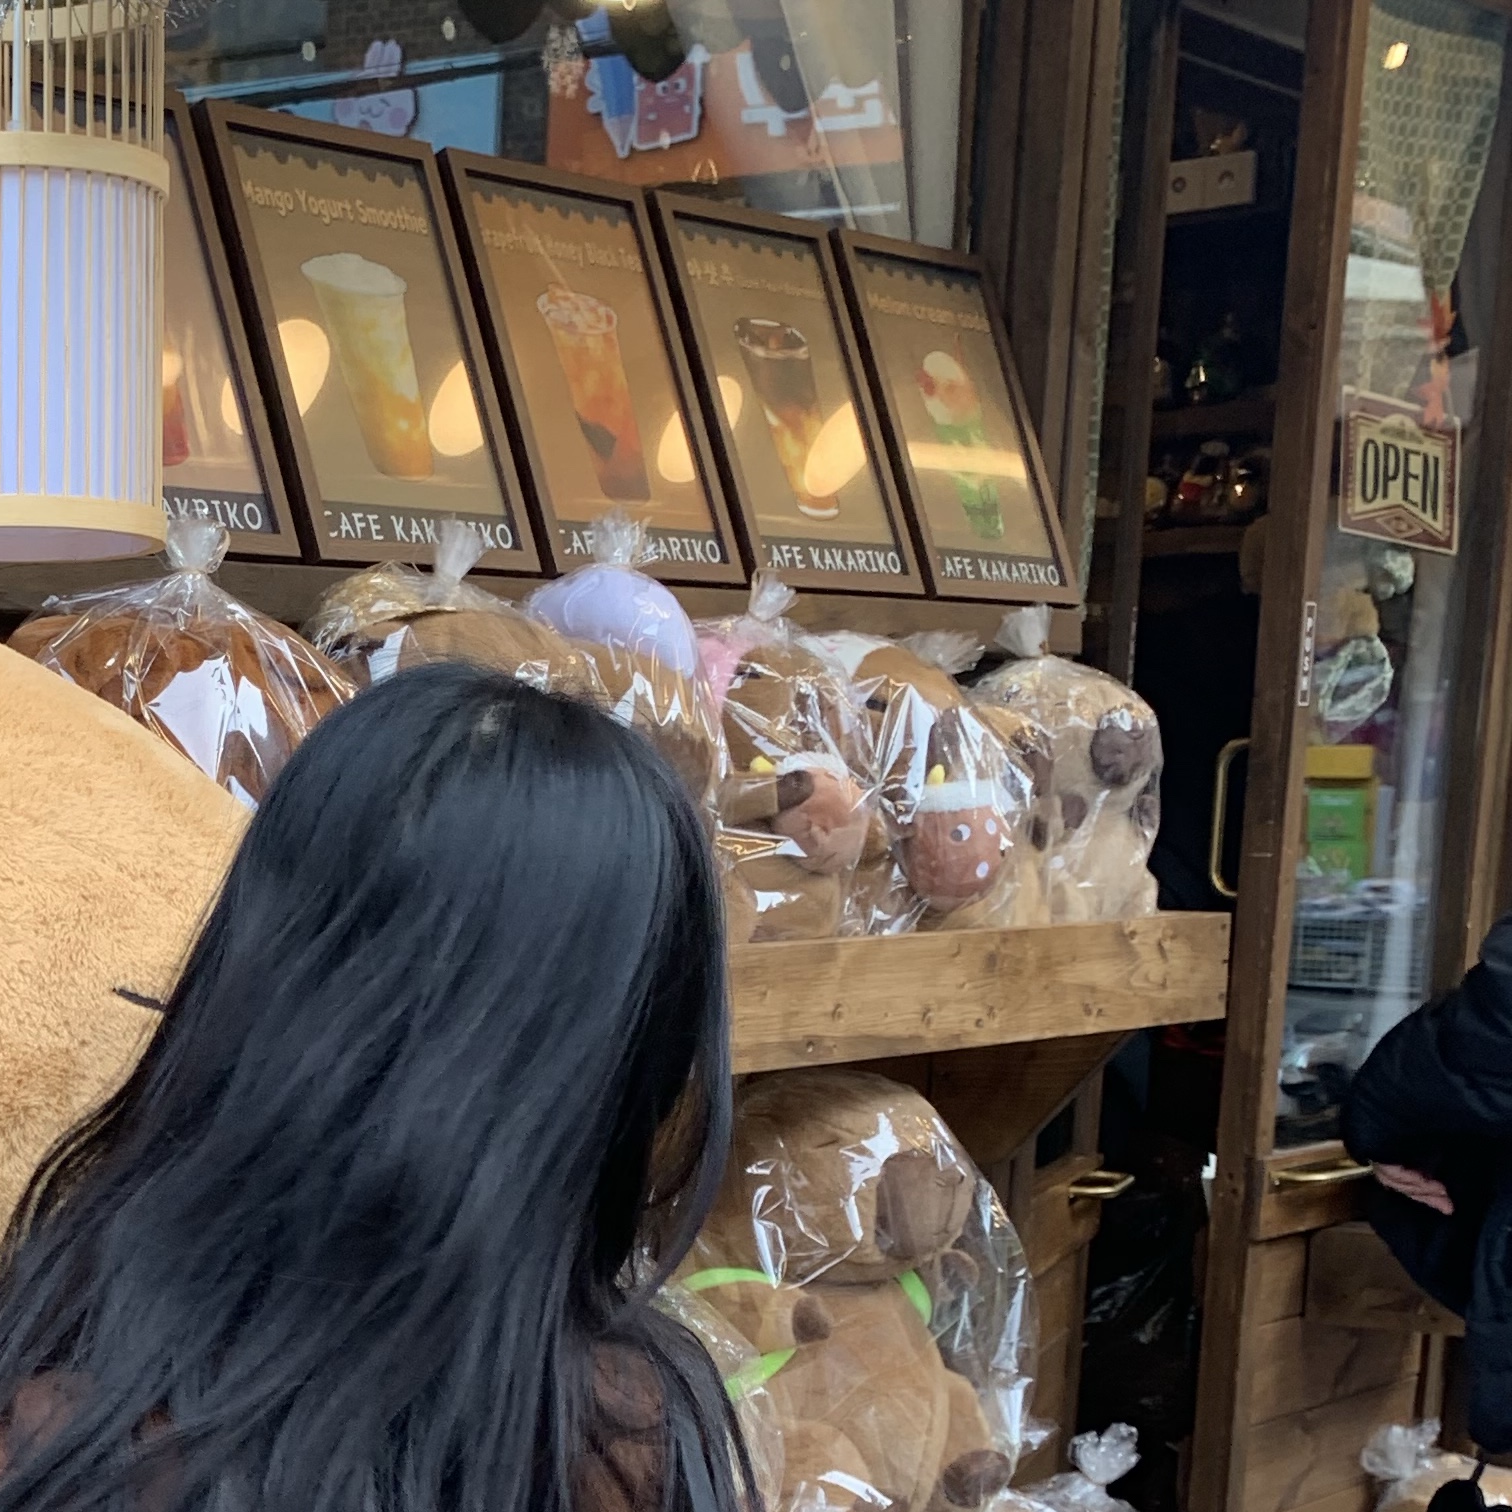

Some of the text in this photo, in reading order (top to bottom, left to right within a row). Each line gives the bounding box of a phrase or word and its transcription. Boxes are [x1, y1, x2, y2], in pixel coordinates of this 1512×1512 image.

[242, 179, 429, 235] Mango Yogurt Smoothie
[1360, 438, 1440, 521] OPEN
[162, 496, 263, 530] AKRIKO
[390, 515, 514, 550] KAKKO
[640, 535, 721, 564] ARIKO
[761, 543, 902, 575] AFE KAKARIKO
[937, 555, 1061, 587] AFE KAKARIKO
